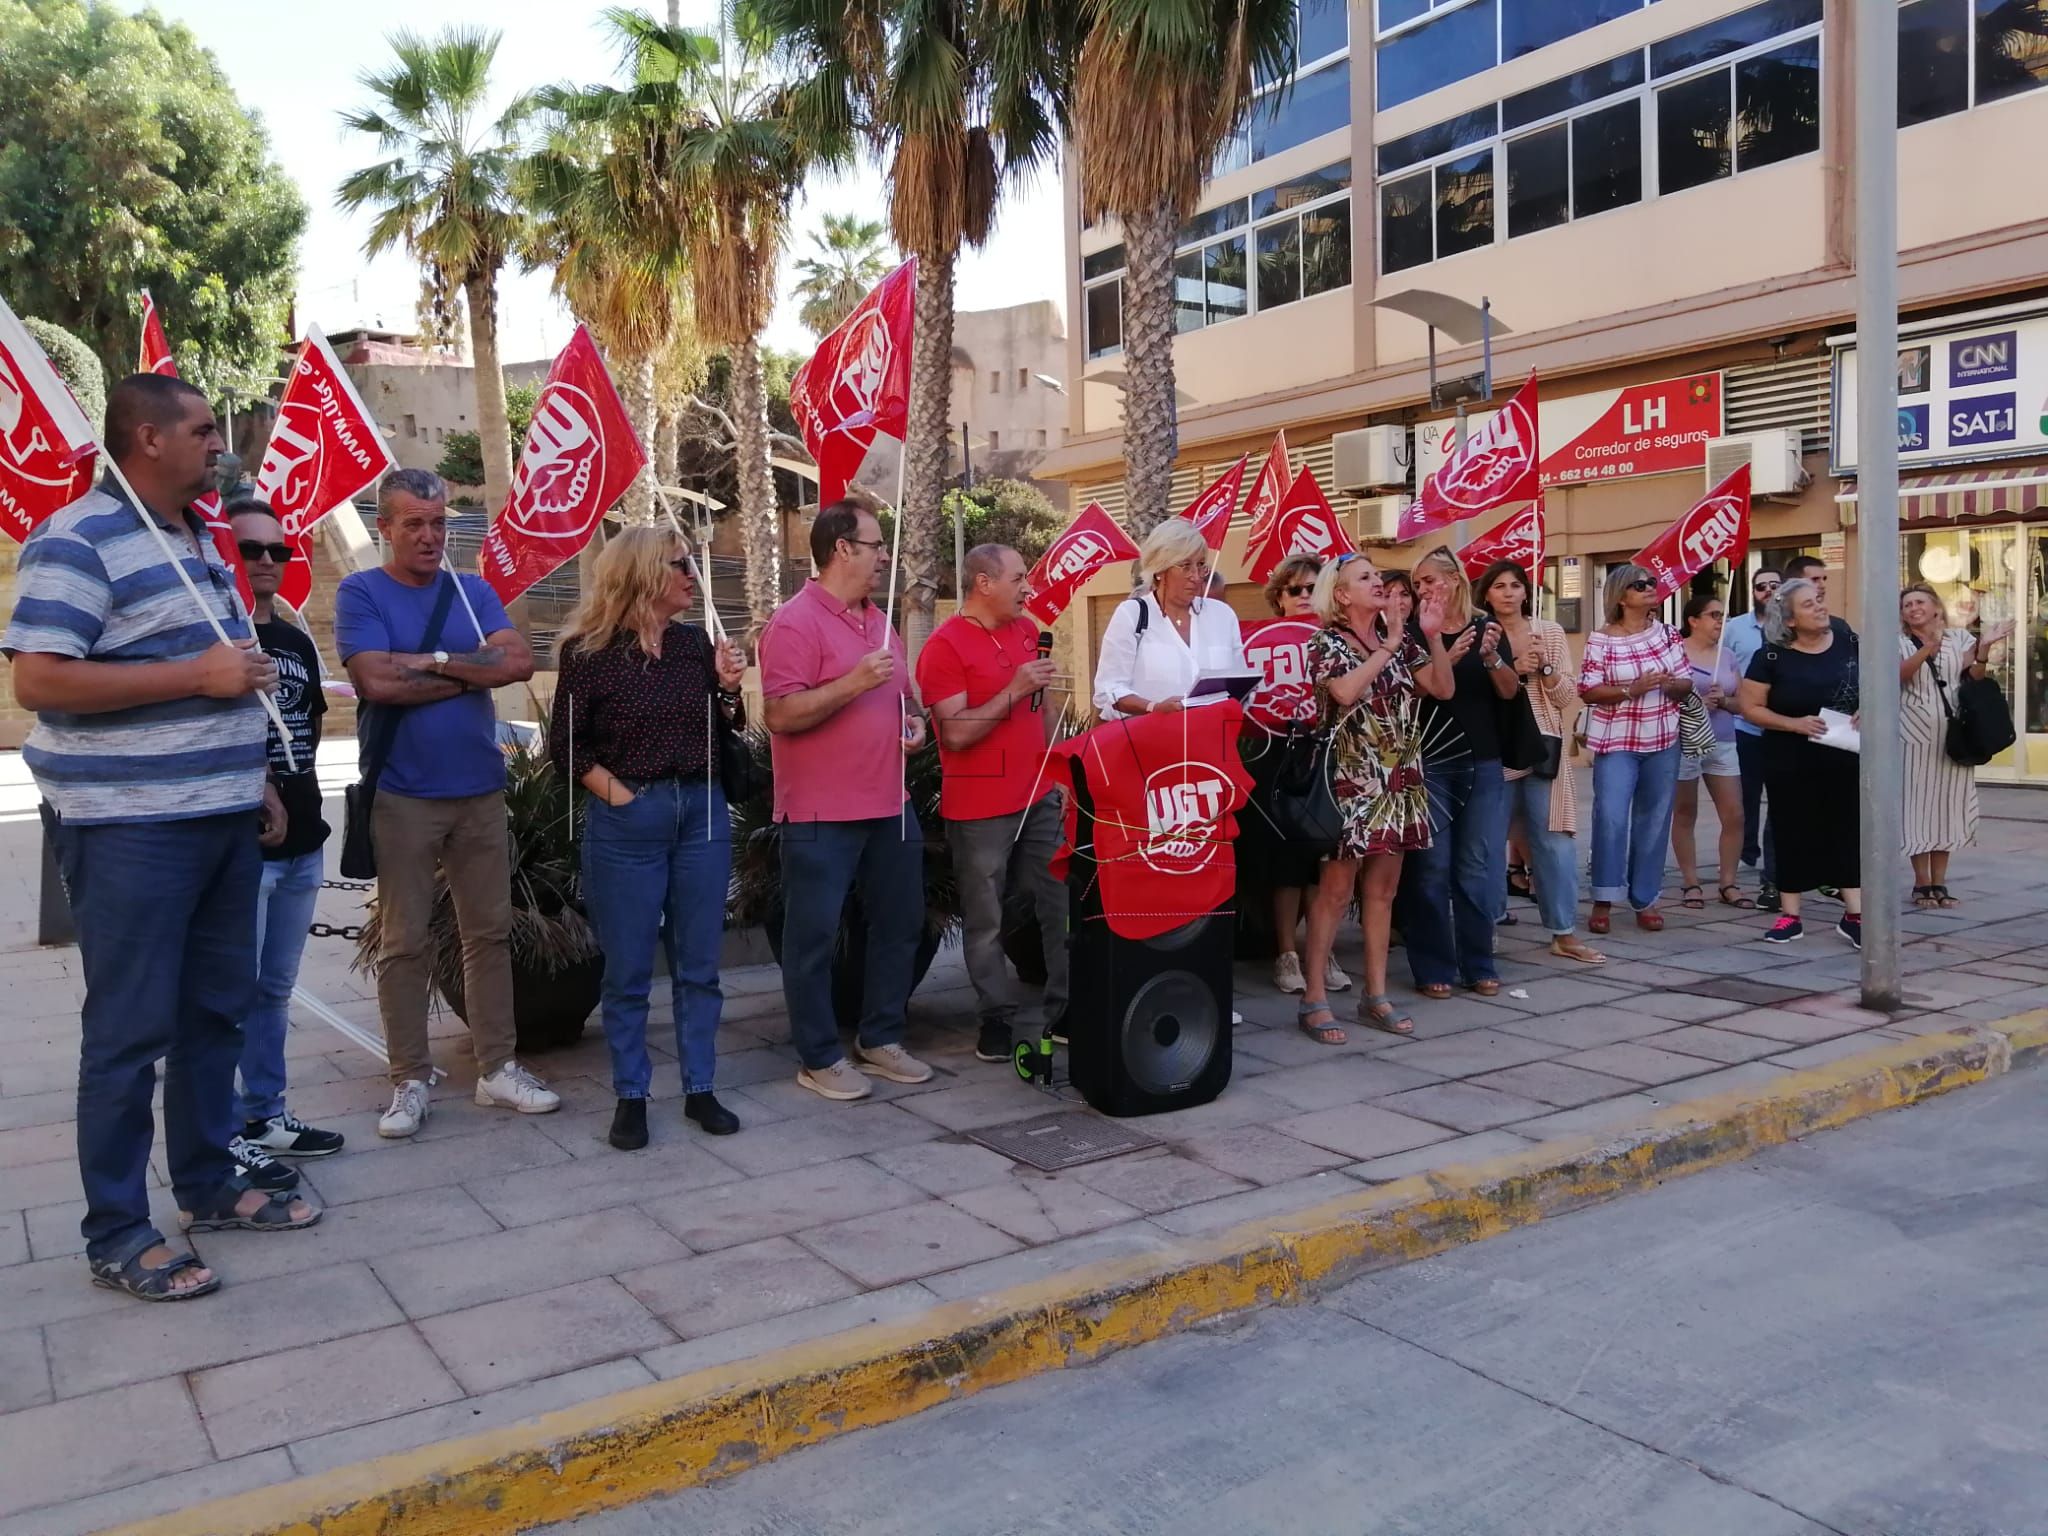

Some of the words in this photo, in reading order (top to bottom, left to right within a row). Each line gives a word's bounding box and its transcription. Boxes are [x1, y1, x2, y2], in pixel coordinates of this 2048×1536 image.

[1958, 341, 2009, 369] CNN
[1957, 365, 2009, 379] INTERNATIONAL
[1623, 396, 1667, 435] LH
[1575, 442, 1631, 460] Corredor
[1634, 437, 1651, 453] de
[1654, 429, 1710, 450] seguros
[1560, 468, 1580, 481] 662
[1584, 466, 1598, 478] 64
[1601, 463, 1616, 476] 48
[1618, 461, 1634, 474] 00
[1147, 778, 1224, 836] UGT
